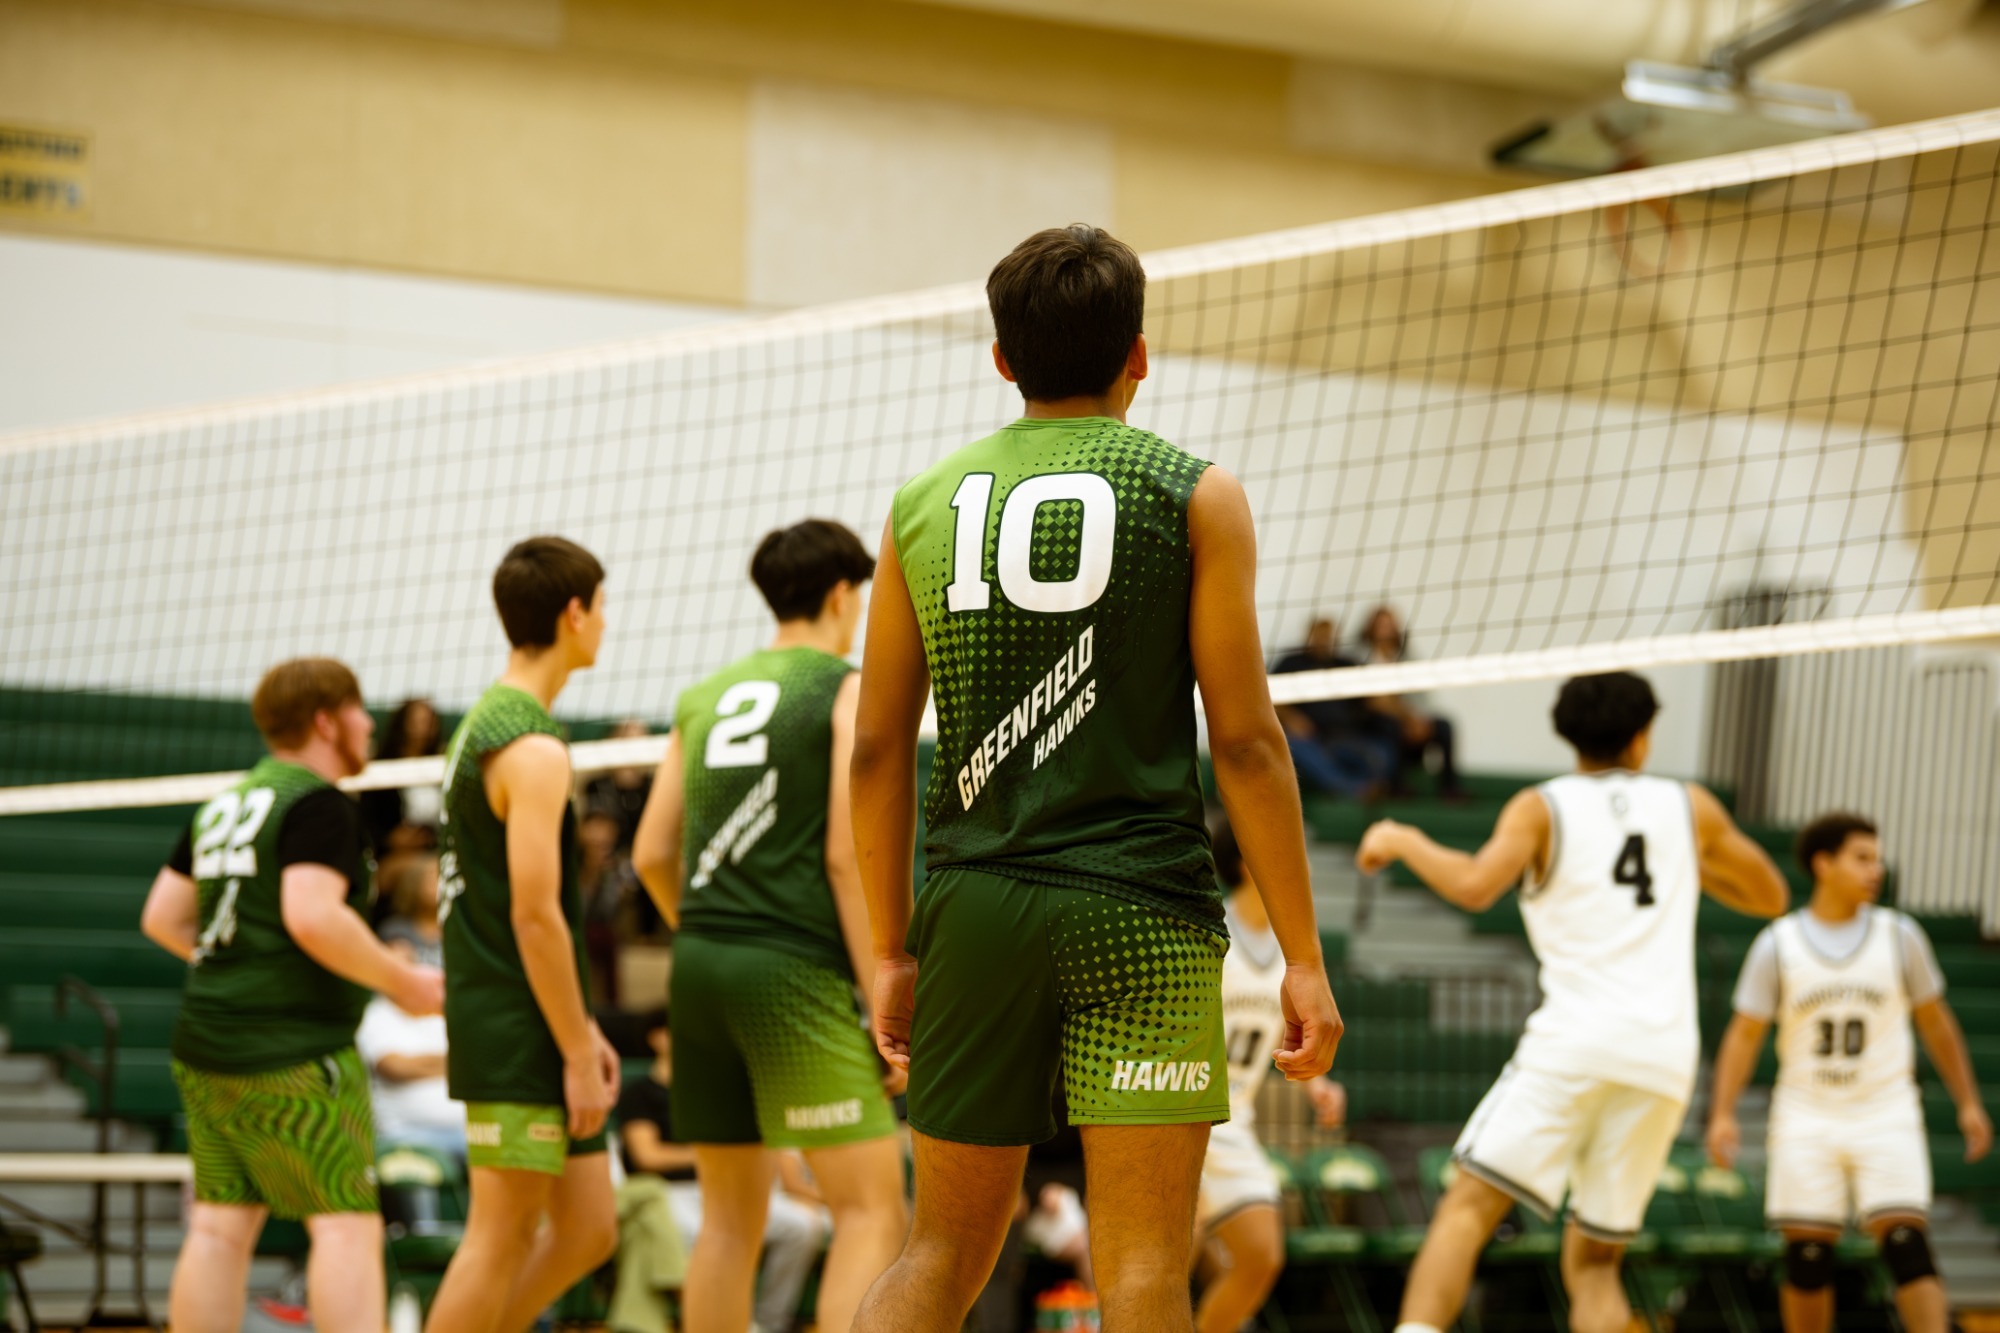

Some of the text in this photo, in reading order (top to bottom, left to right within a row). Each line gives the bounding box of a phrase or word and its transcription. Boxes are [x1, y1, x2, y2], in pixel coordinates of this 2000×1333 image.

[947, 472, 1116, 612] 10
[704, 680, 781, 769] 2
[957, 625, 1094, 812] GREENFIELD
[1032, 678, 1096, 771] HAWKS
[193, 786, 275, 880] 22
[1613, 833, 1655, 906] 4
[1111, 1060, 1211, 1091] HAWKS
[1815, 1018, 1865, 1057] 30
